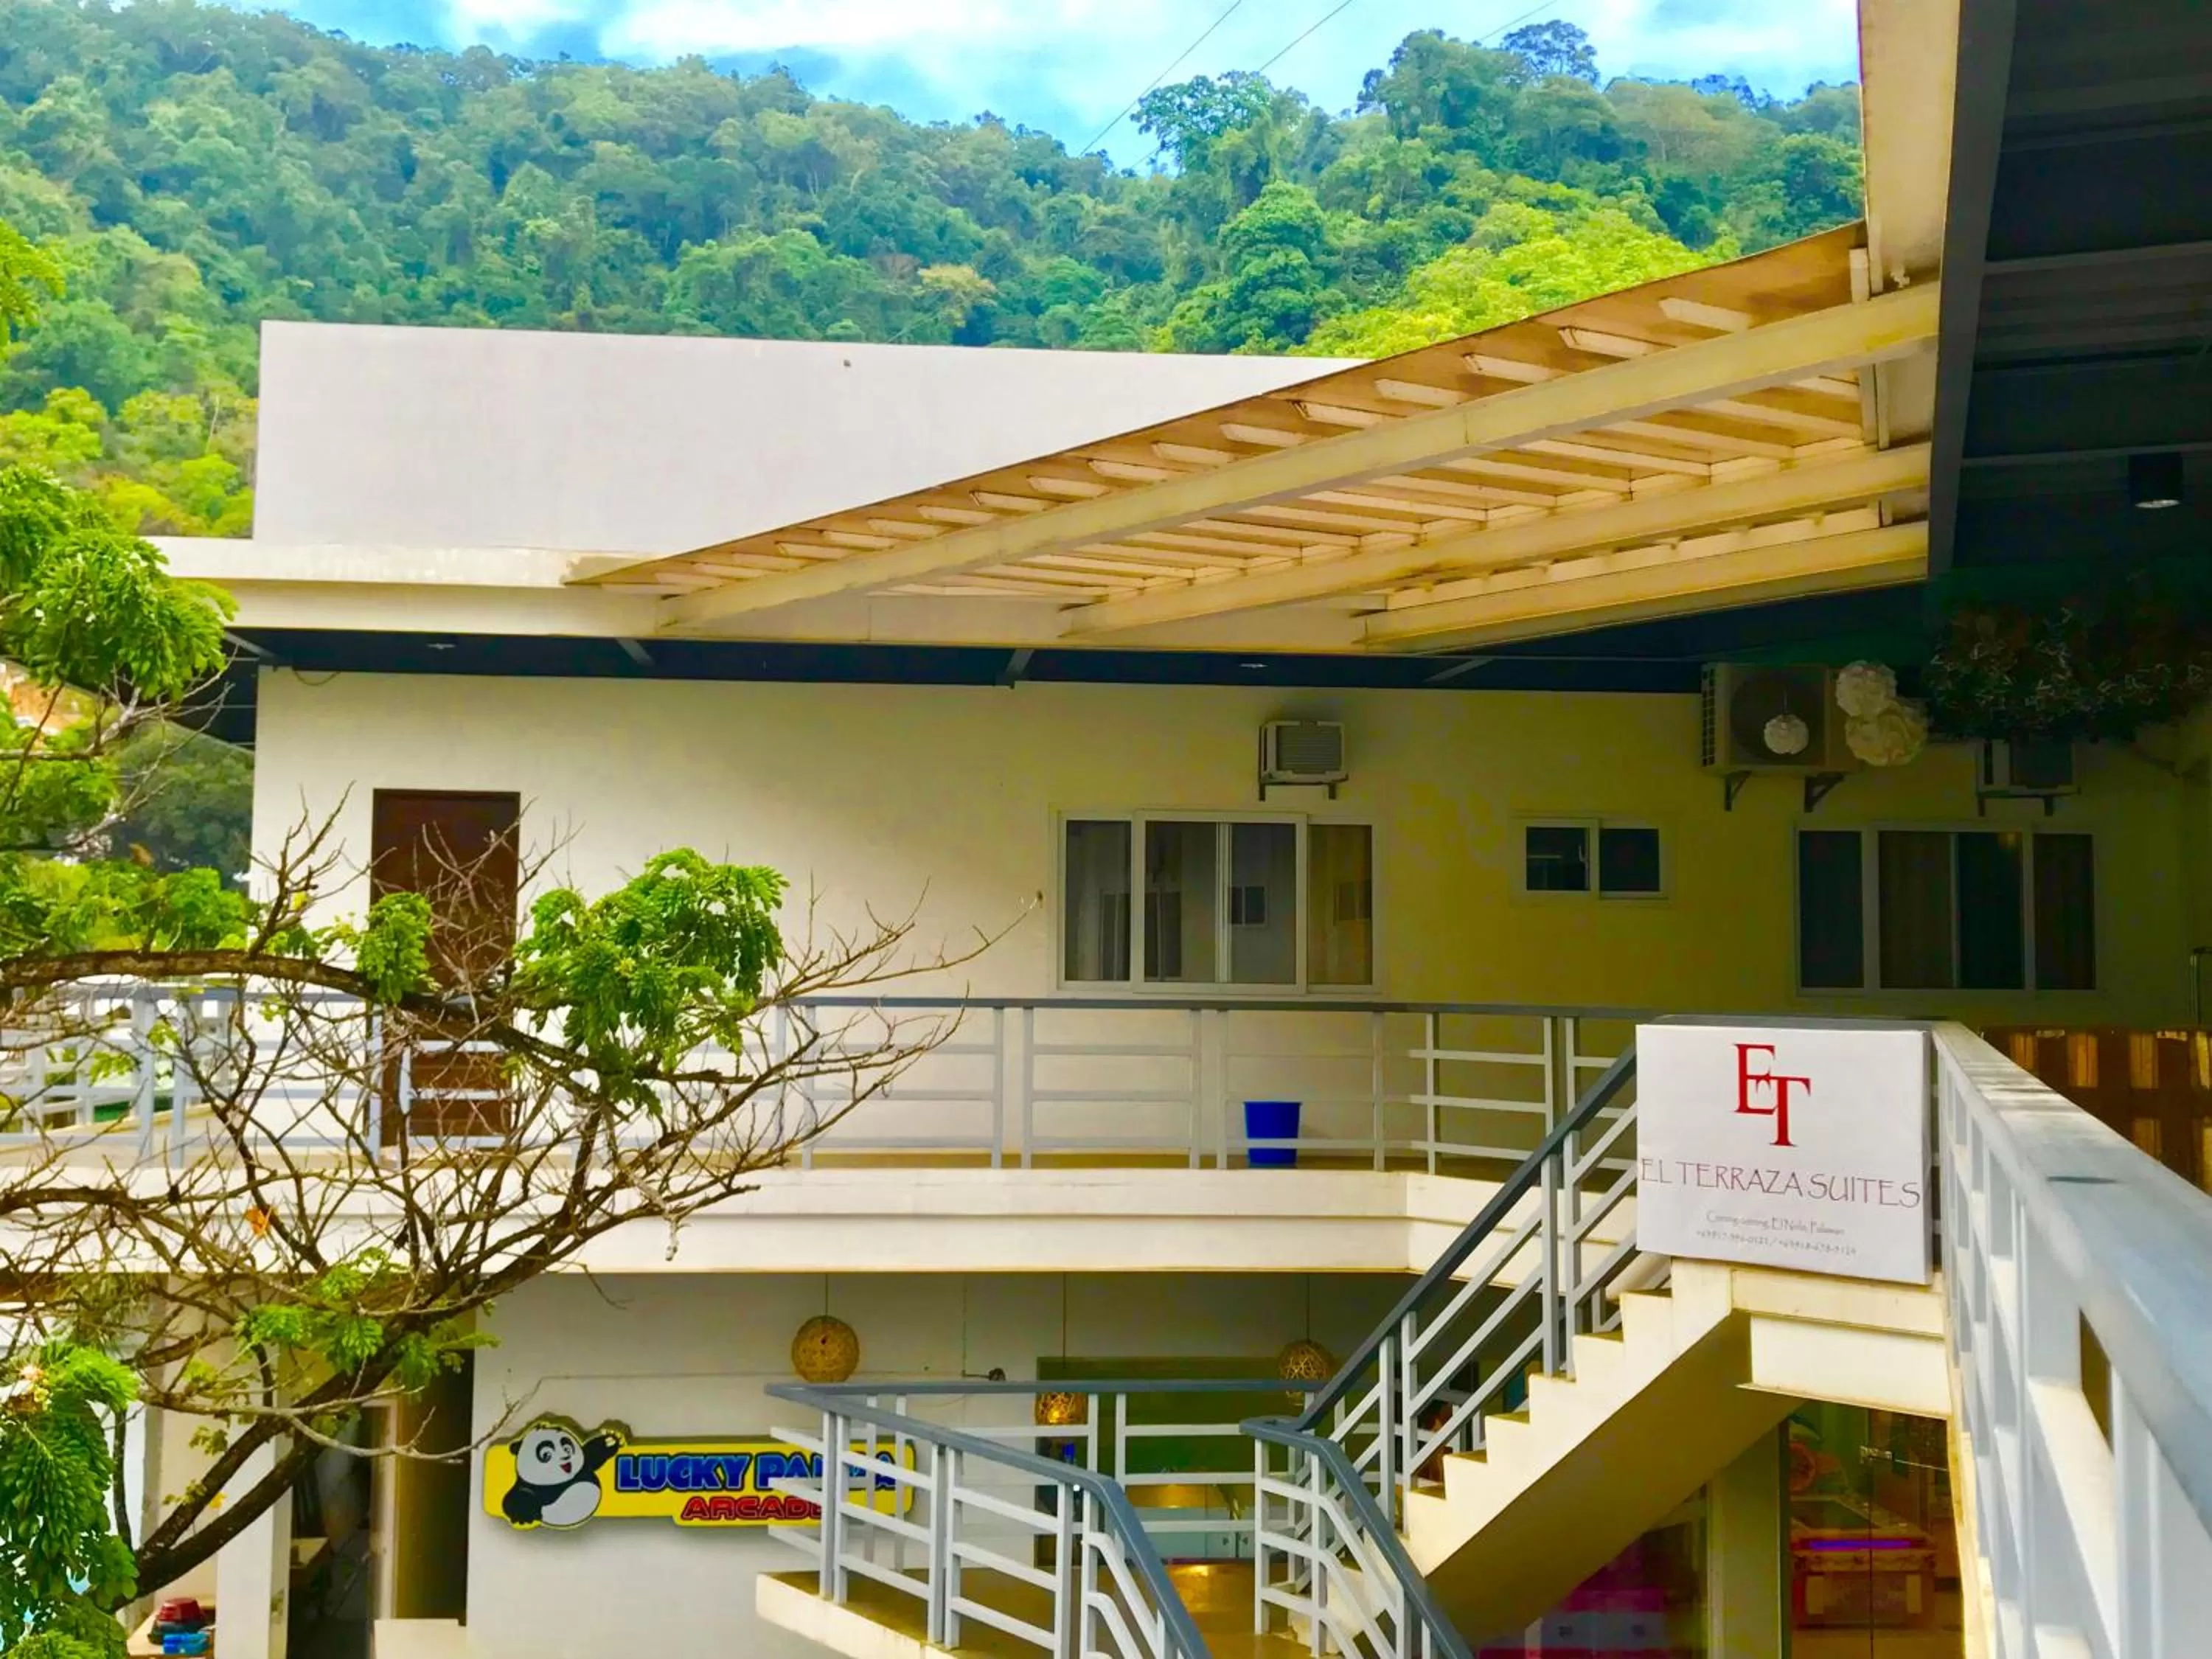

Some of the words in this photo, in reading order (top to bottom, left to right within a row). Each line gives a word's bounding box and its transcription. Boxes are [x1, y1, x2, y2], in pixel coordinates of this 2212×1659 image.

[1641, 1158, 1674, 1184] EL
[1675, 1161, 1804, 1198] TERRAZA
[1807, 1172, 1921, 1208] SUITES
[616, 1451, 751, 1492] LUCKY
